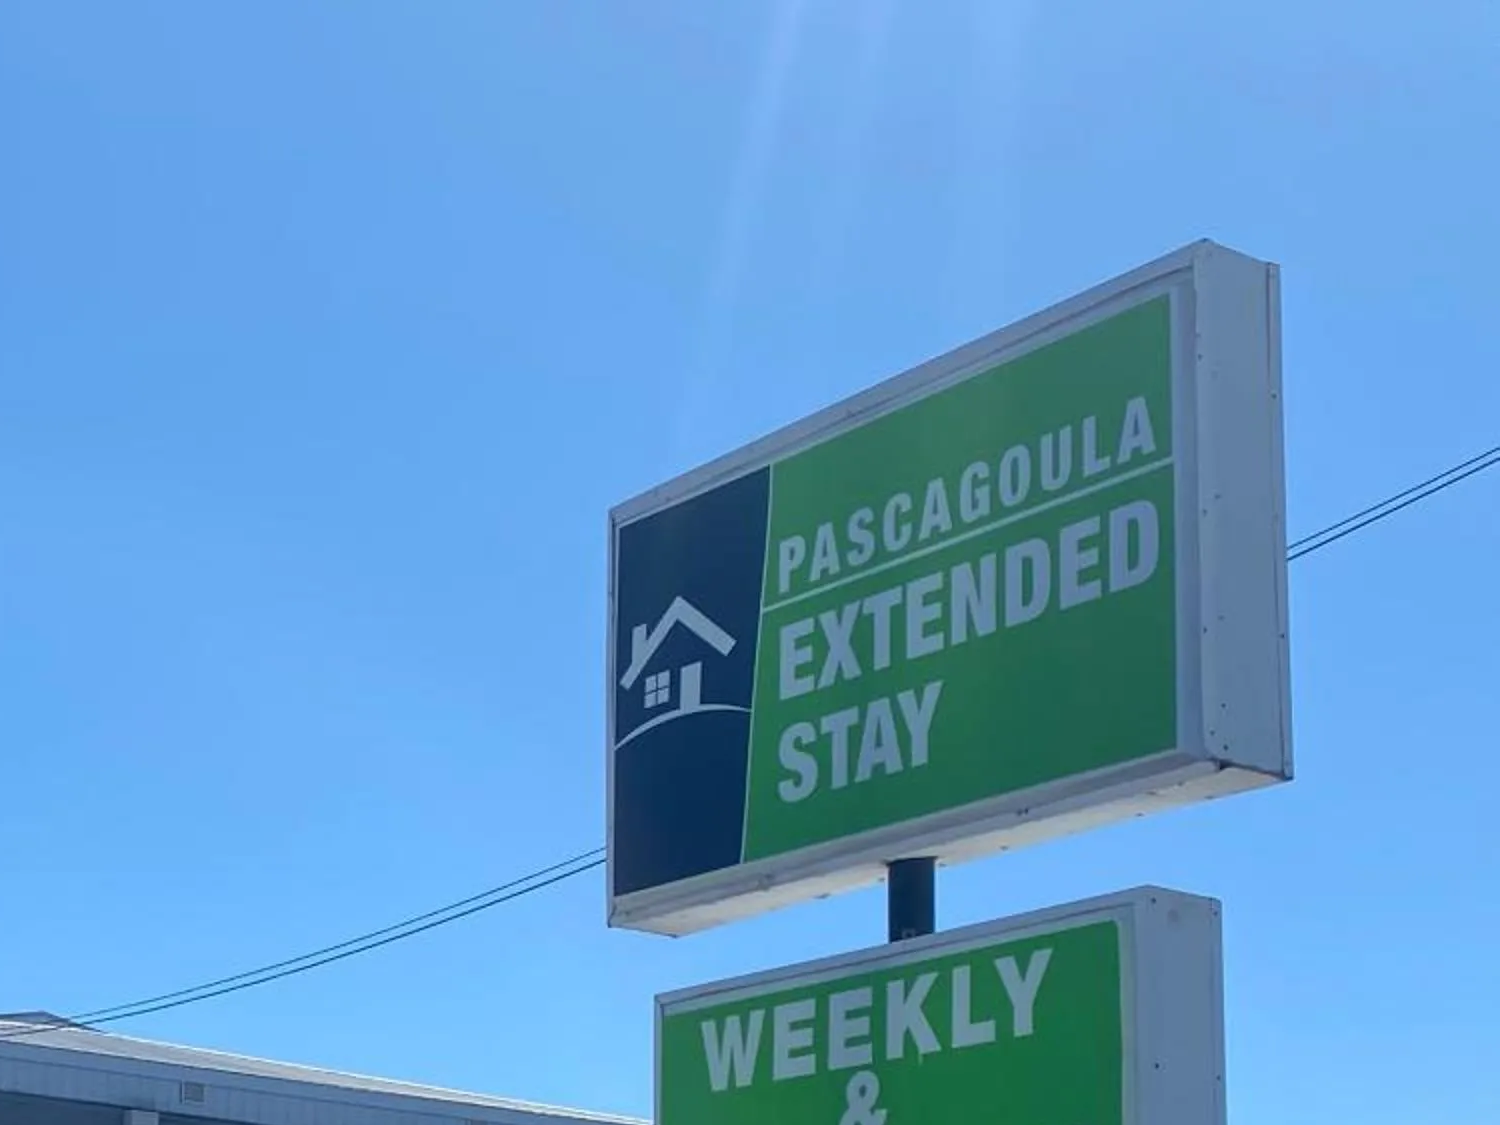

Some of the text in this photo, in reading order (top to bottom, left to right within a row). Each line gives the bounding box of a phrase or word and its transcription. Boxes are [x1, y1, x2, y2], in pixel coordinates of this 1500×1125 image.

[778, 396, 1157, 595] PASCAGOULA
[778, 500, 1160, 700] EXTENDED
[776, 681, 943, 803] STAY
[701, 948, 1053, 1092] WEEKLY
